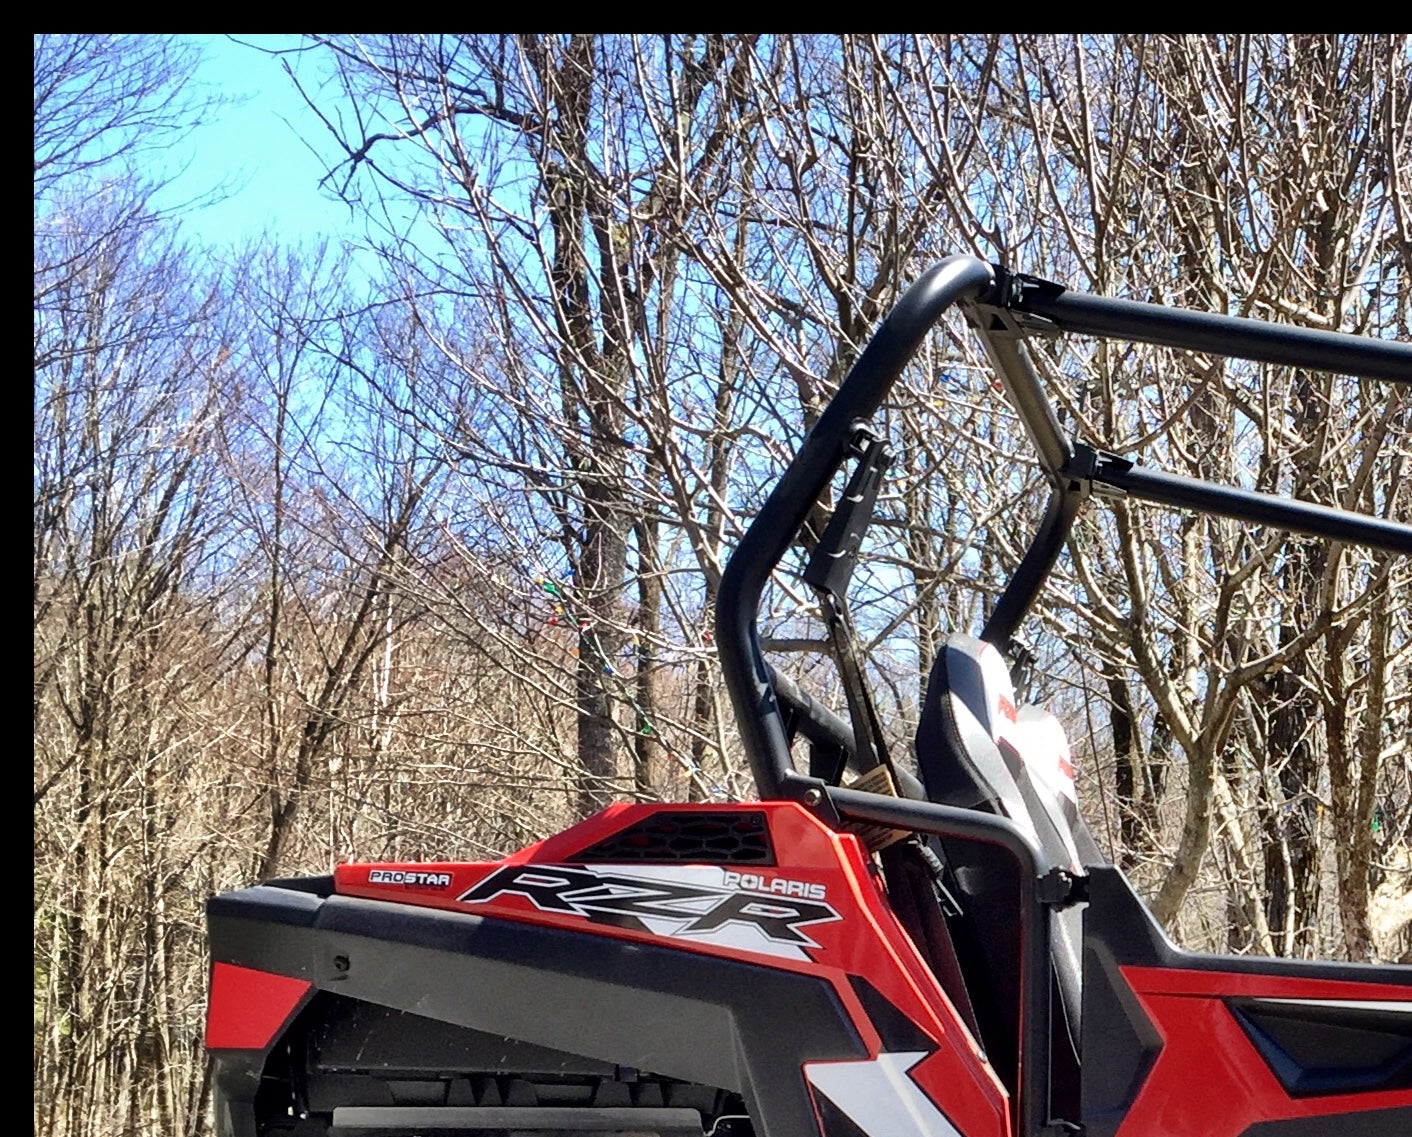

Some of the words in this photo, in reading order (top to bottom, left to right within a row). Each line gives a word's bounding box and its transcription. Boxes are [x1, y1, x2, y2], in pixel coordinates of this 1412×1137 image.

[370, 871, 450, 886] PROSTAR
[724, 871, 826, 900] POLARIS
[456, 864, 843, 949] RZR
